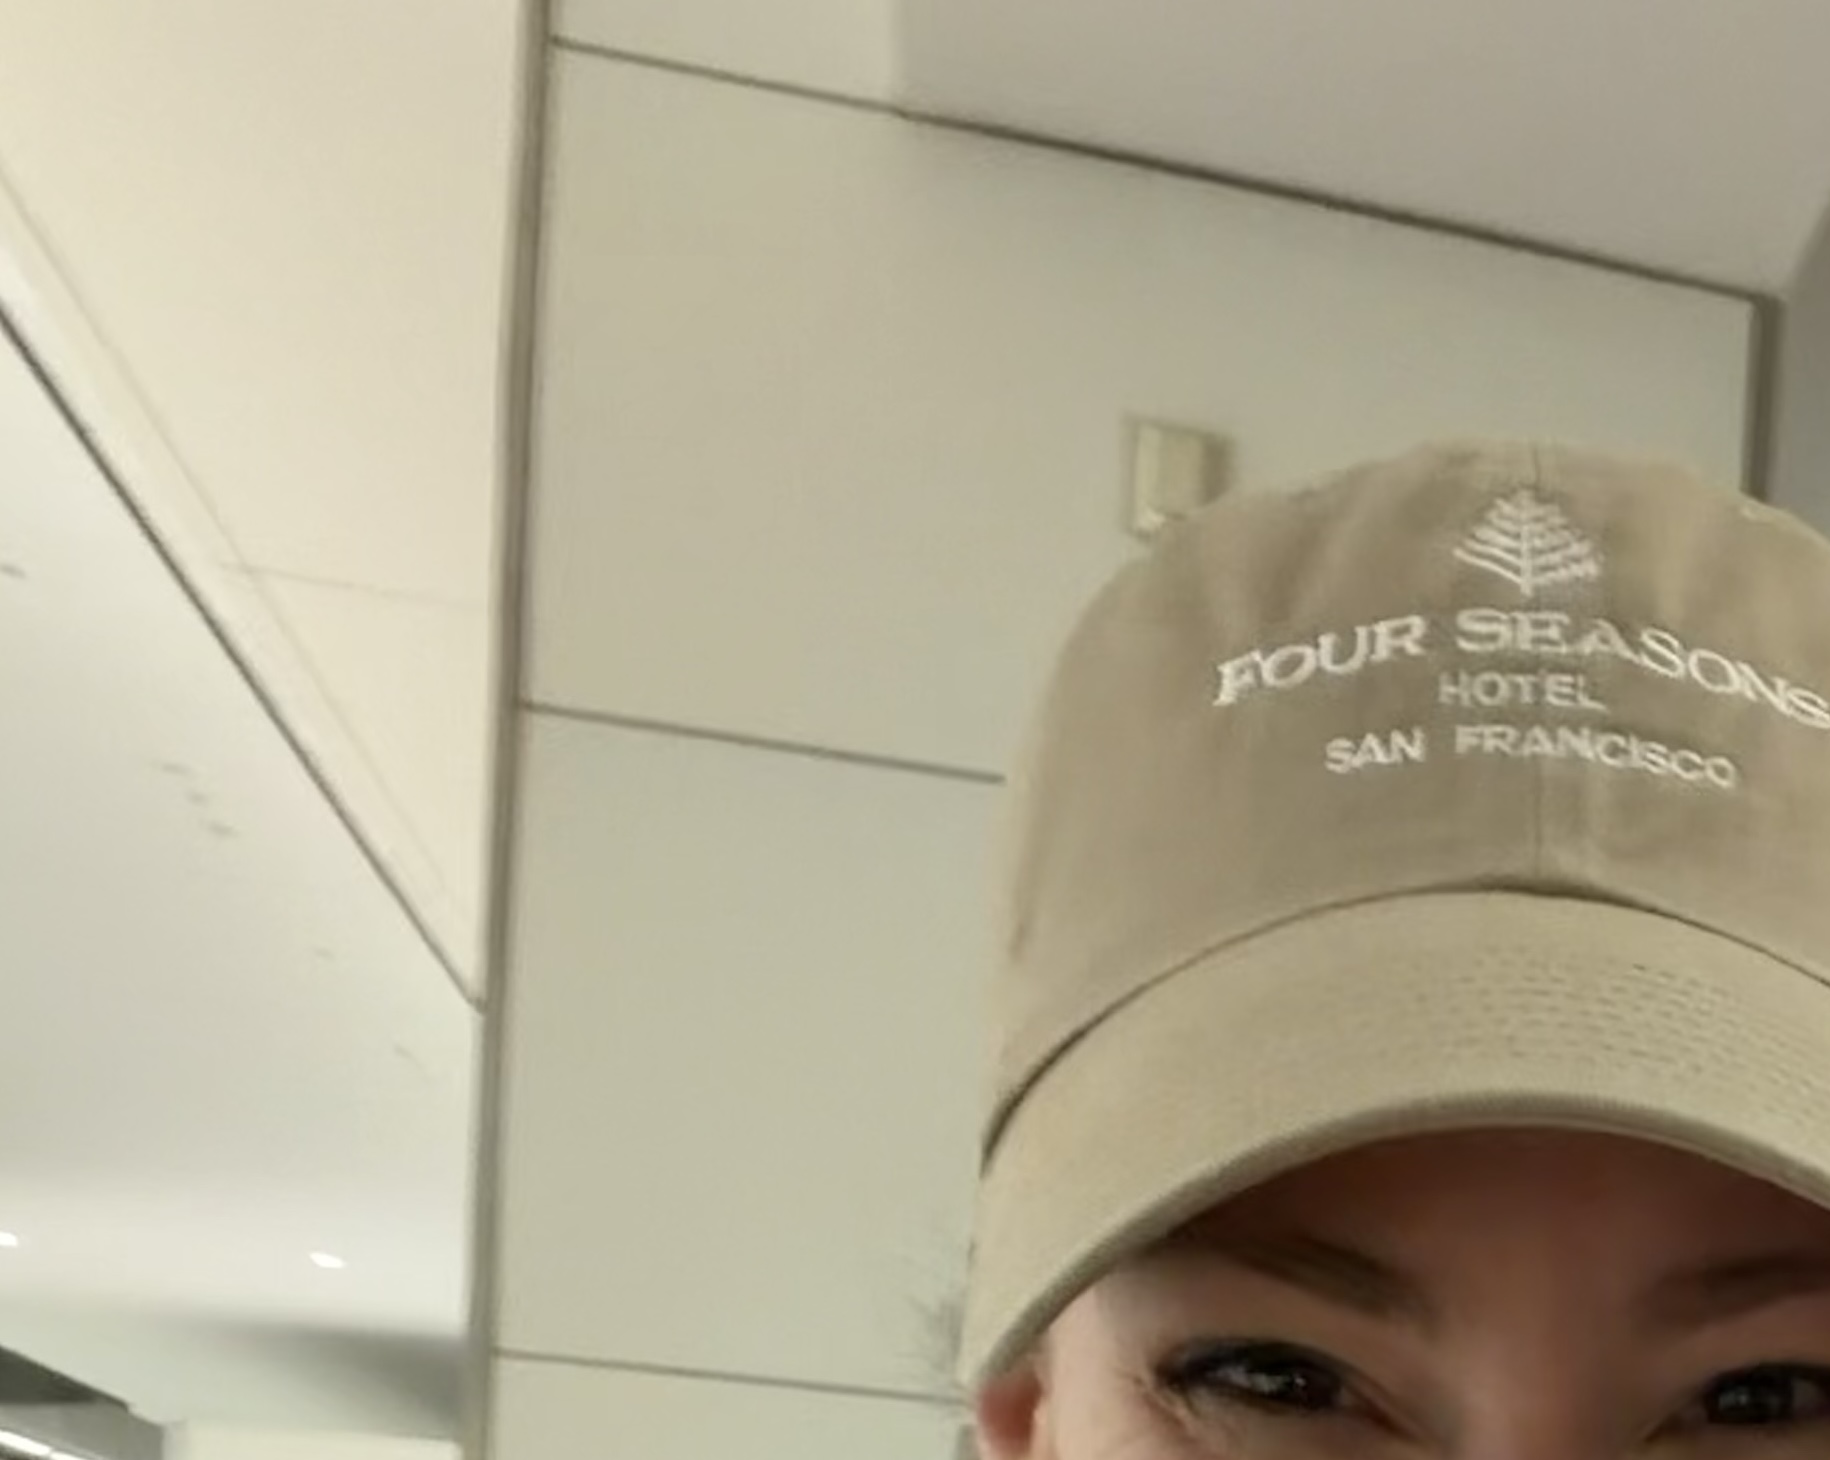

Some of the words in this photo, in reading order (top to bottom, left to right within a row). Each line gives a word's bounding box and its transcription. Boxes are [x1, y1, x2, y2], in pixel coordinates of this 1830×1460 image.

[1213, 614, 1426, 706] FOUR
[1438, 670, 1607, 714] HOTEL
[1325, 728, 1426, 774] SAN
[1455, 724, 1737, 790] FRANCISCO
